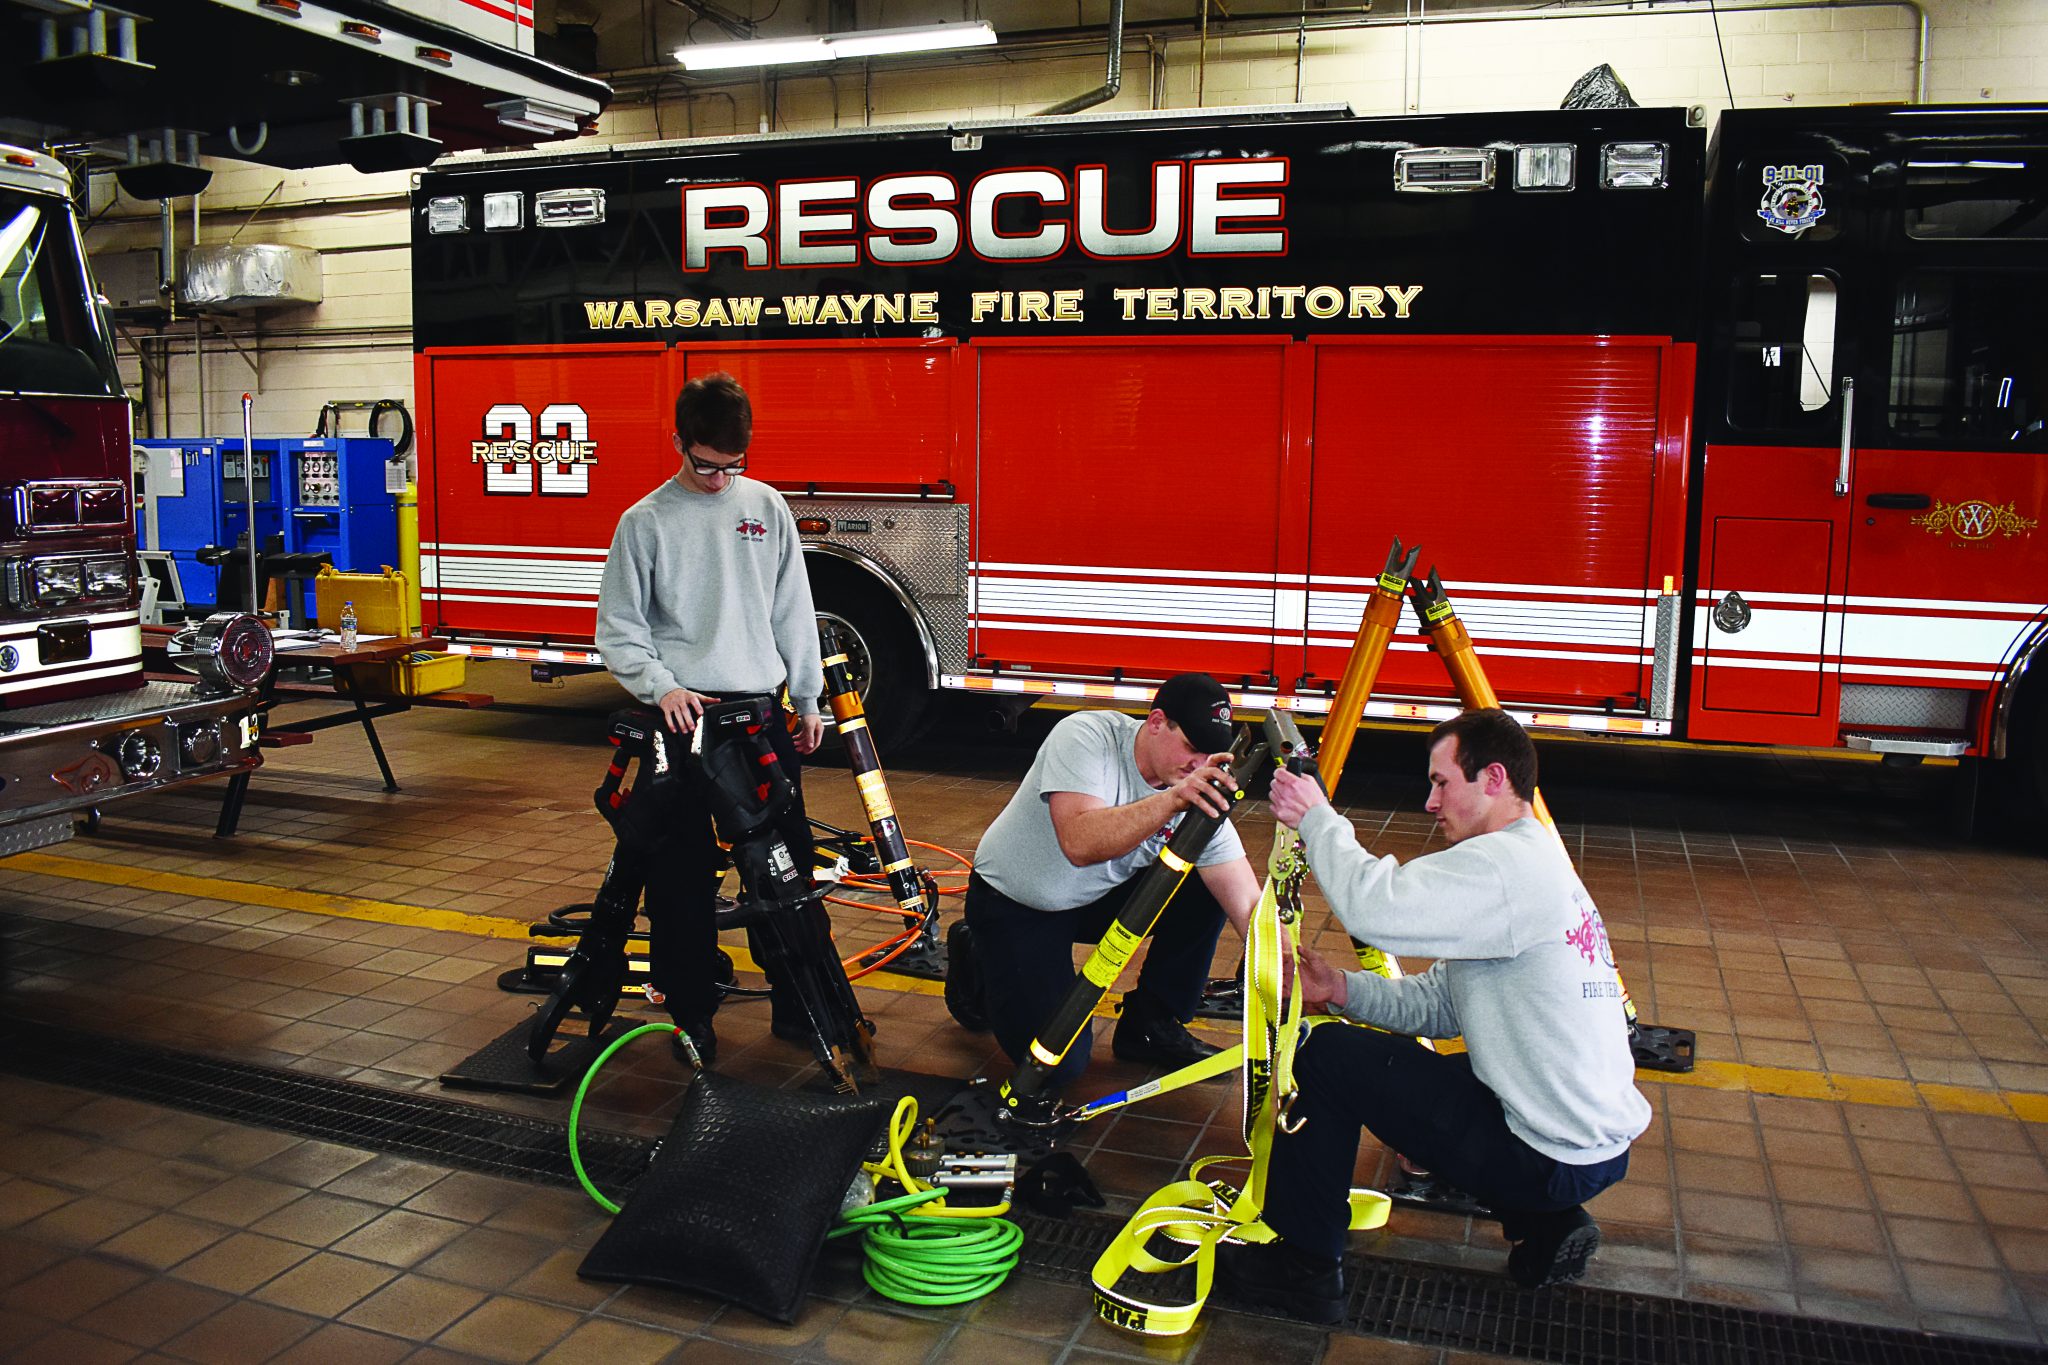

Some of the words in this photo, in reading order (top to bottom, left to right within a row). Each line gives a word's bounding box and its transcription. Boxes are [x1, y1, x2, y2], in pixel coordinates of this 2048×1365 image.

[1763, 165, 1823, 185] 9-11-01
[682, 157, 1289, 272] RESCUE
[584, 292, 939, 329] WARSAW-WAYNE
[971, 289, 1084, 323] FIRE
[1114, 286, 1423, 321] TERRITORY
[471, 441, 598, 464] RESCUE
[837, 520, 867, 532] MARION
